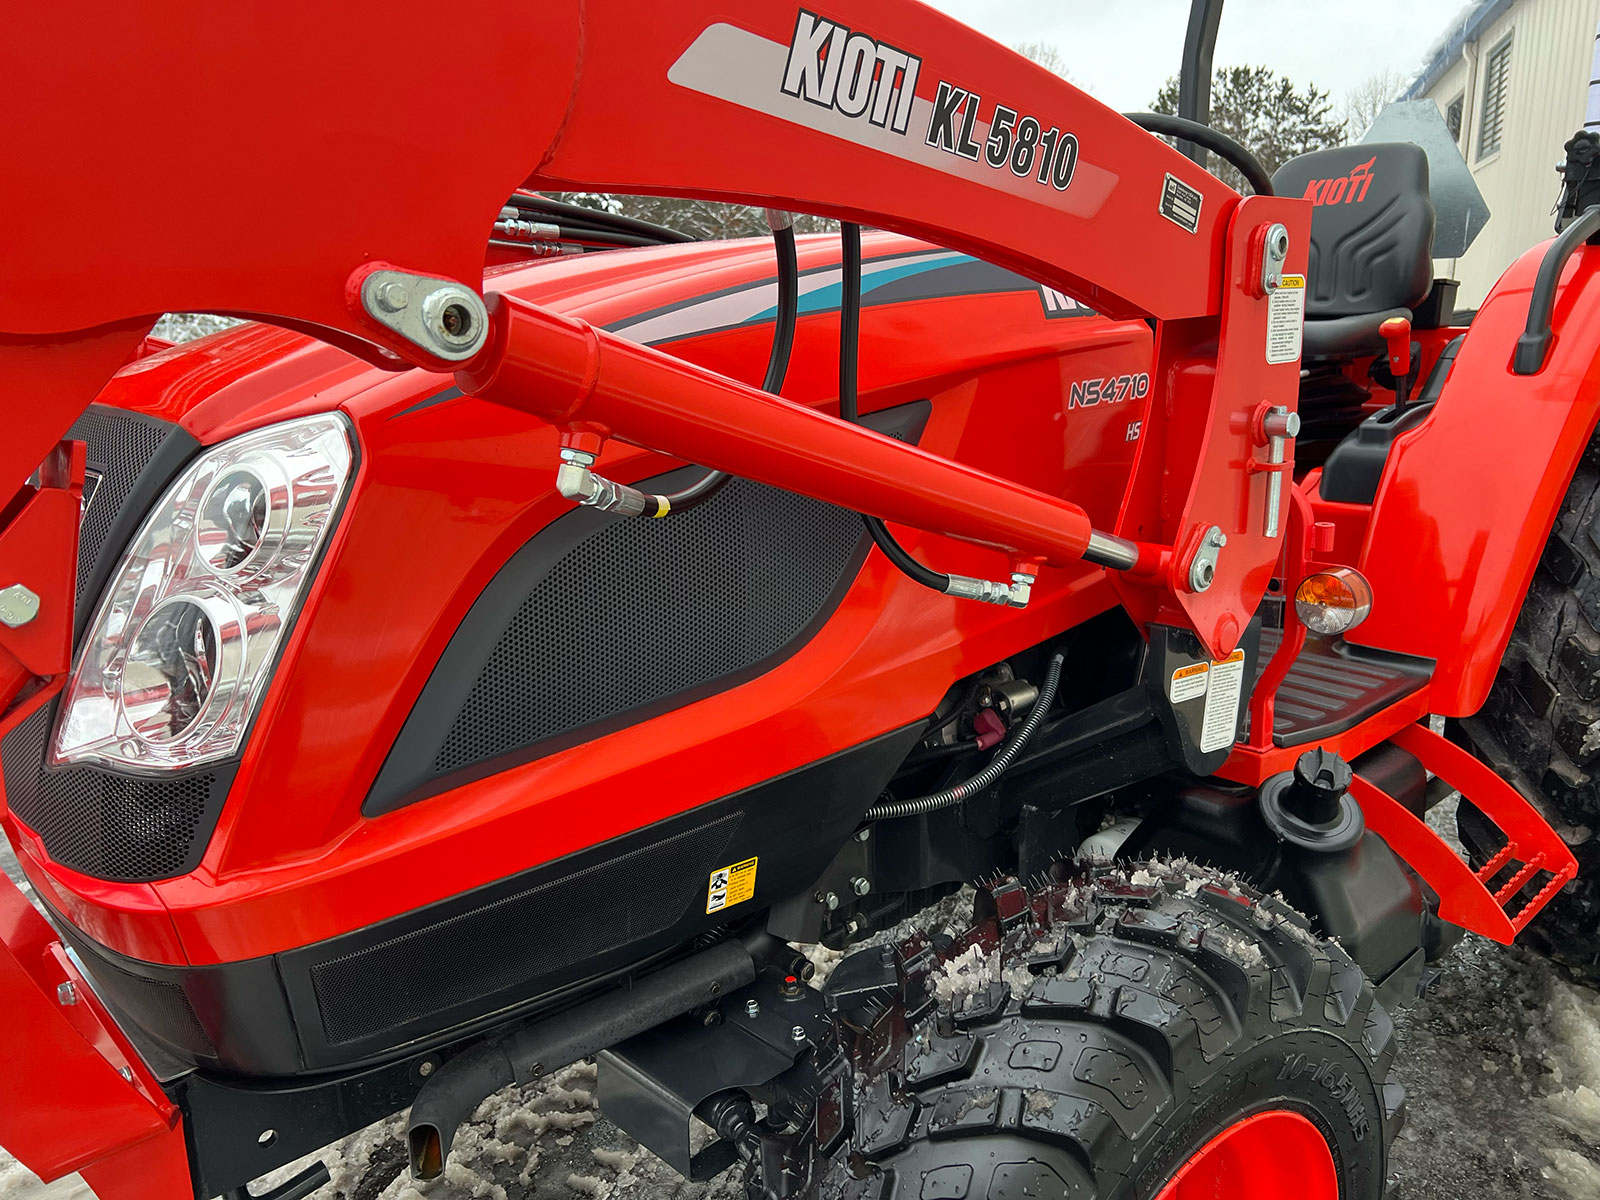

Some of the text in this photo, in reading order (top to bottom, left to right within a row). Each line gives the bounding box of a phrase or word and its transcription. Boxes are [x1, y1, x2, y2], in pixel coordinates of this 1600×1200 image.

[781, 7, 1079, 191] KIOTI KL 5810
[1303, 172, 1375, 207] KIOTI
[1282, 279, 1300, 287] CAUTION
[1068, 372, 1150, 410] NS4710
